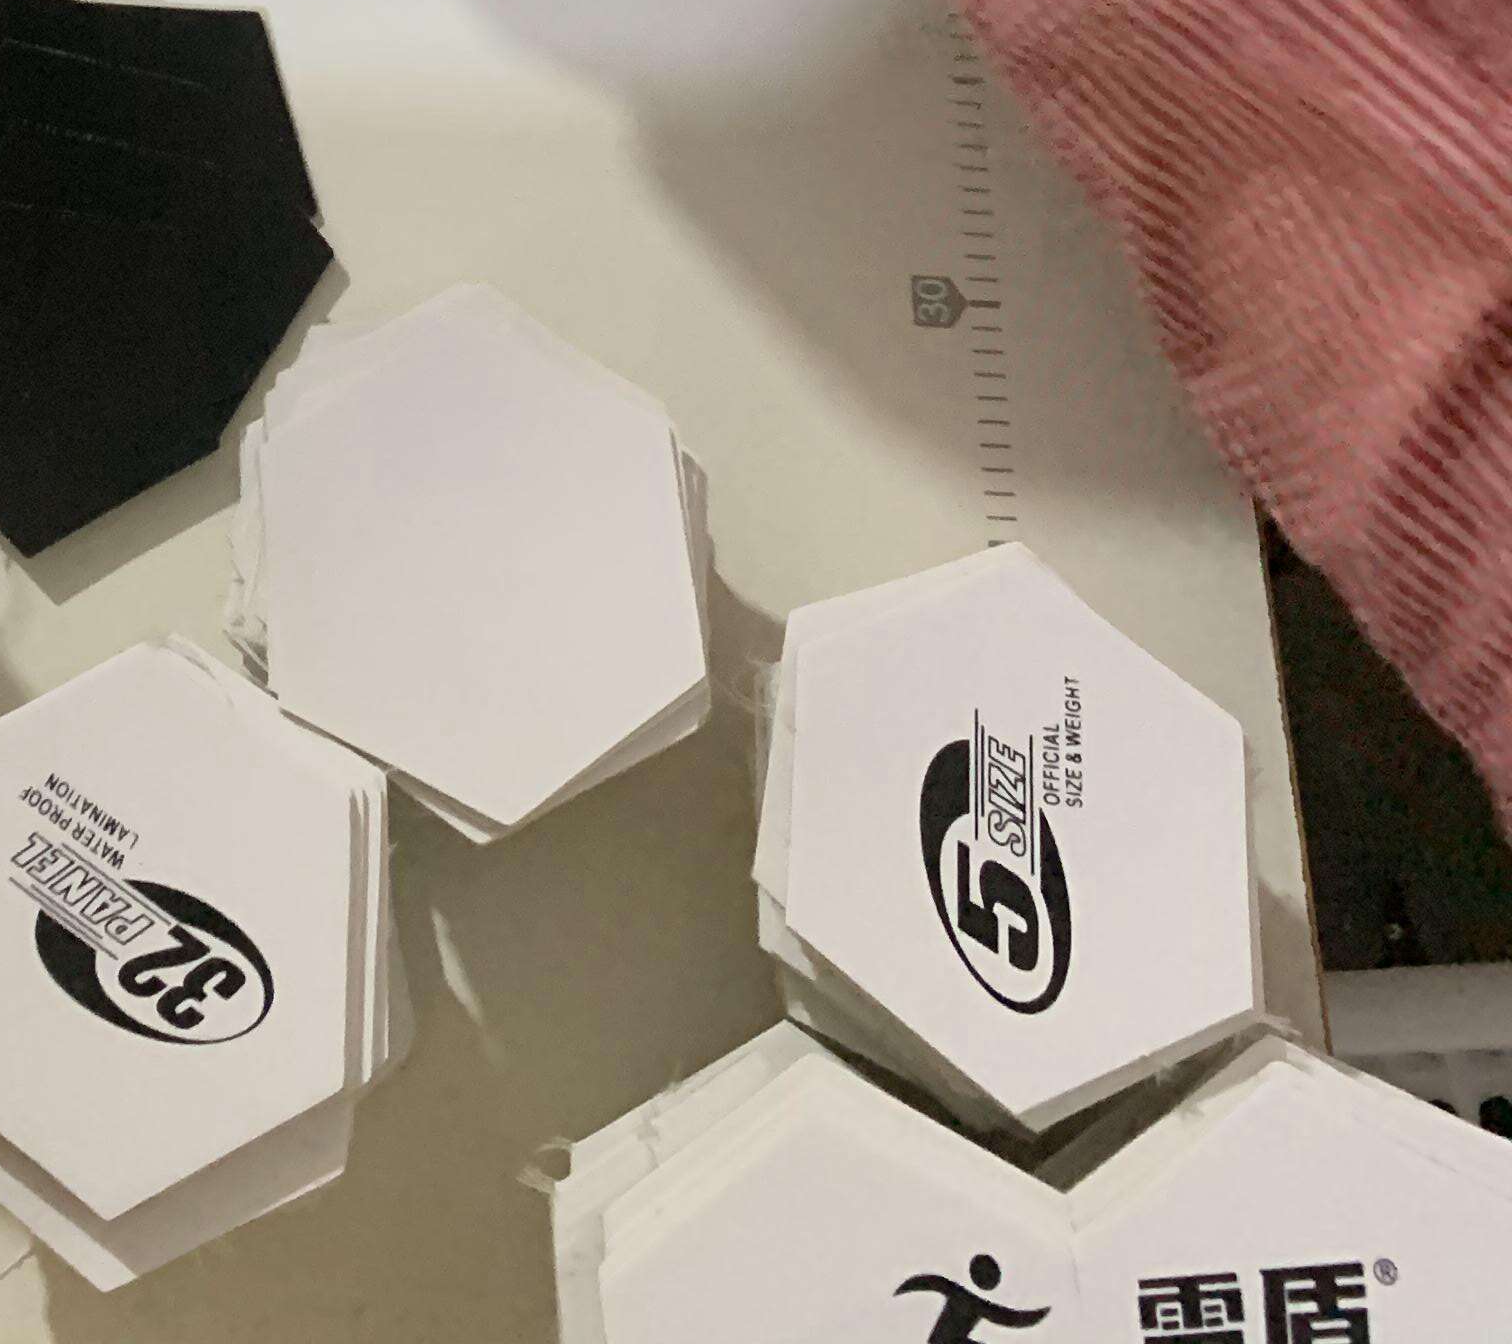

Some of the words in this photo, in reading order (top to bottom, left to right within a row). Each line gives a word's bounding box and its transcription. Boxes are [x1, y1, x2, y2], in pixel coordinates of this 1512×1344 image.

[918, 278, 948, 323] 30
[1063, 675, 1083, 749] WEIGHT
[988, 735, 1028, 857] SIZE
[1042, 723, 1062, 807] OFFICIAL
[1064, 766, 1084, 809] SIZE
[19, 785, 73, 831] PROOF
[44, 772, 139, 850] LAMINATION
[70, 823, 126, 870] WATER
[9, 831, 156, 946] PANEL
[957, 840, 1040, 973] 5
[117, 924, 247, 1030] 32
